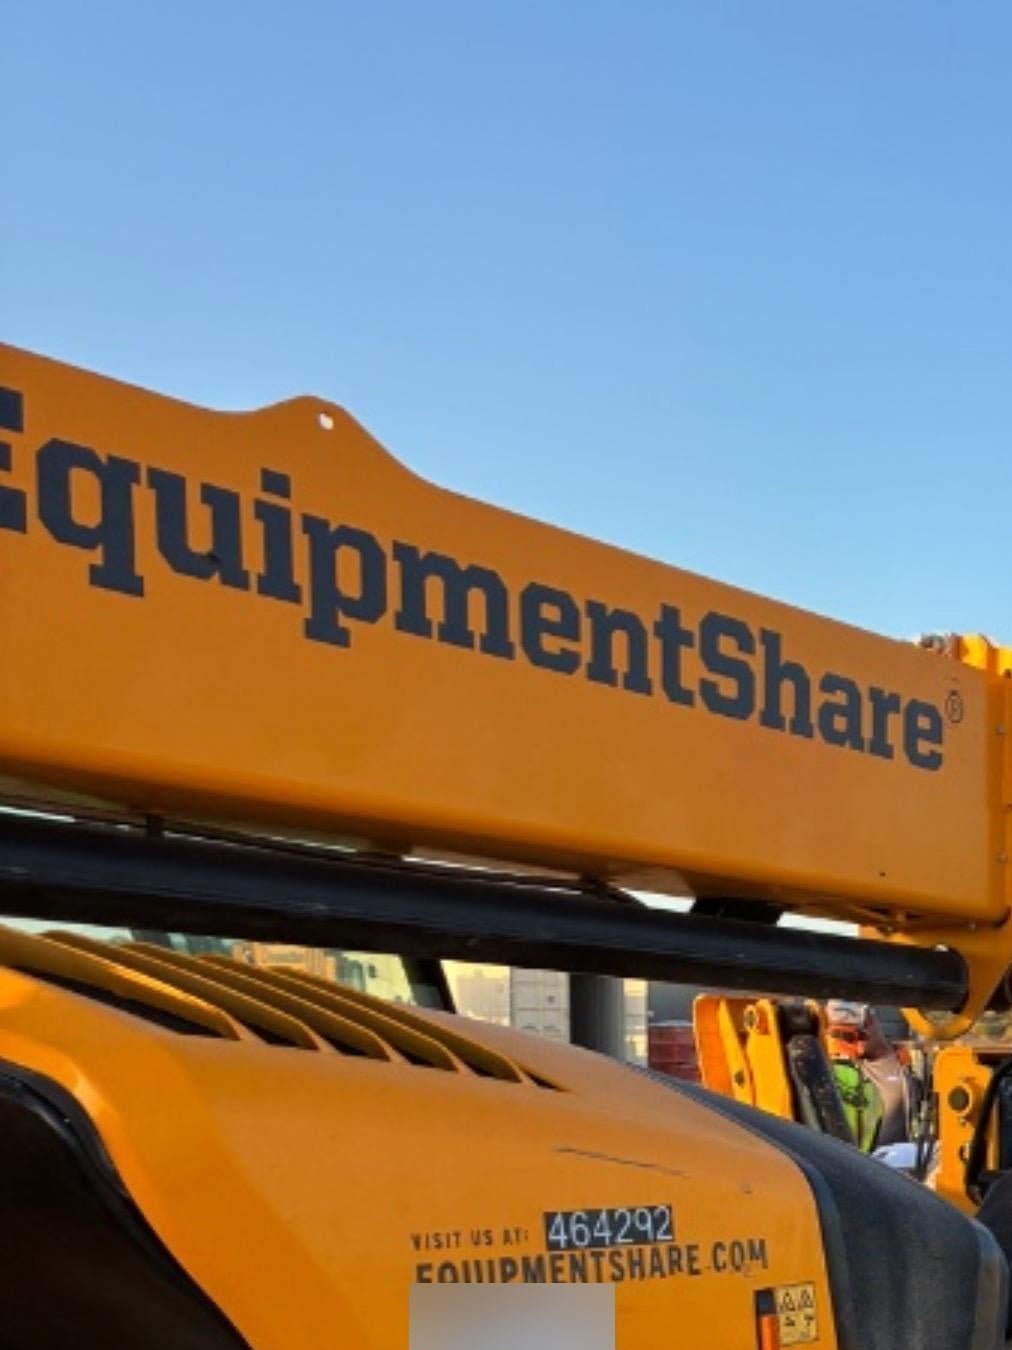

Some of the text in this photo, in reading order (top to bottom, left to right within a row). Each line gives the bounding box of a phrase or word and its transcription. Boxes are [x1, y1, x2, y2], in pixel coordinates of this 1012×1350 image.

[411, 1226, 529, 1251] VISIT US AT:
[549, 1205, 673, 1249] 464292
